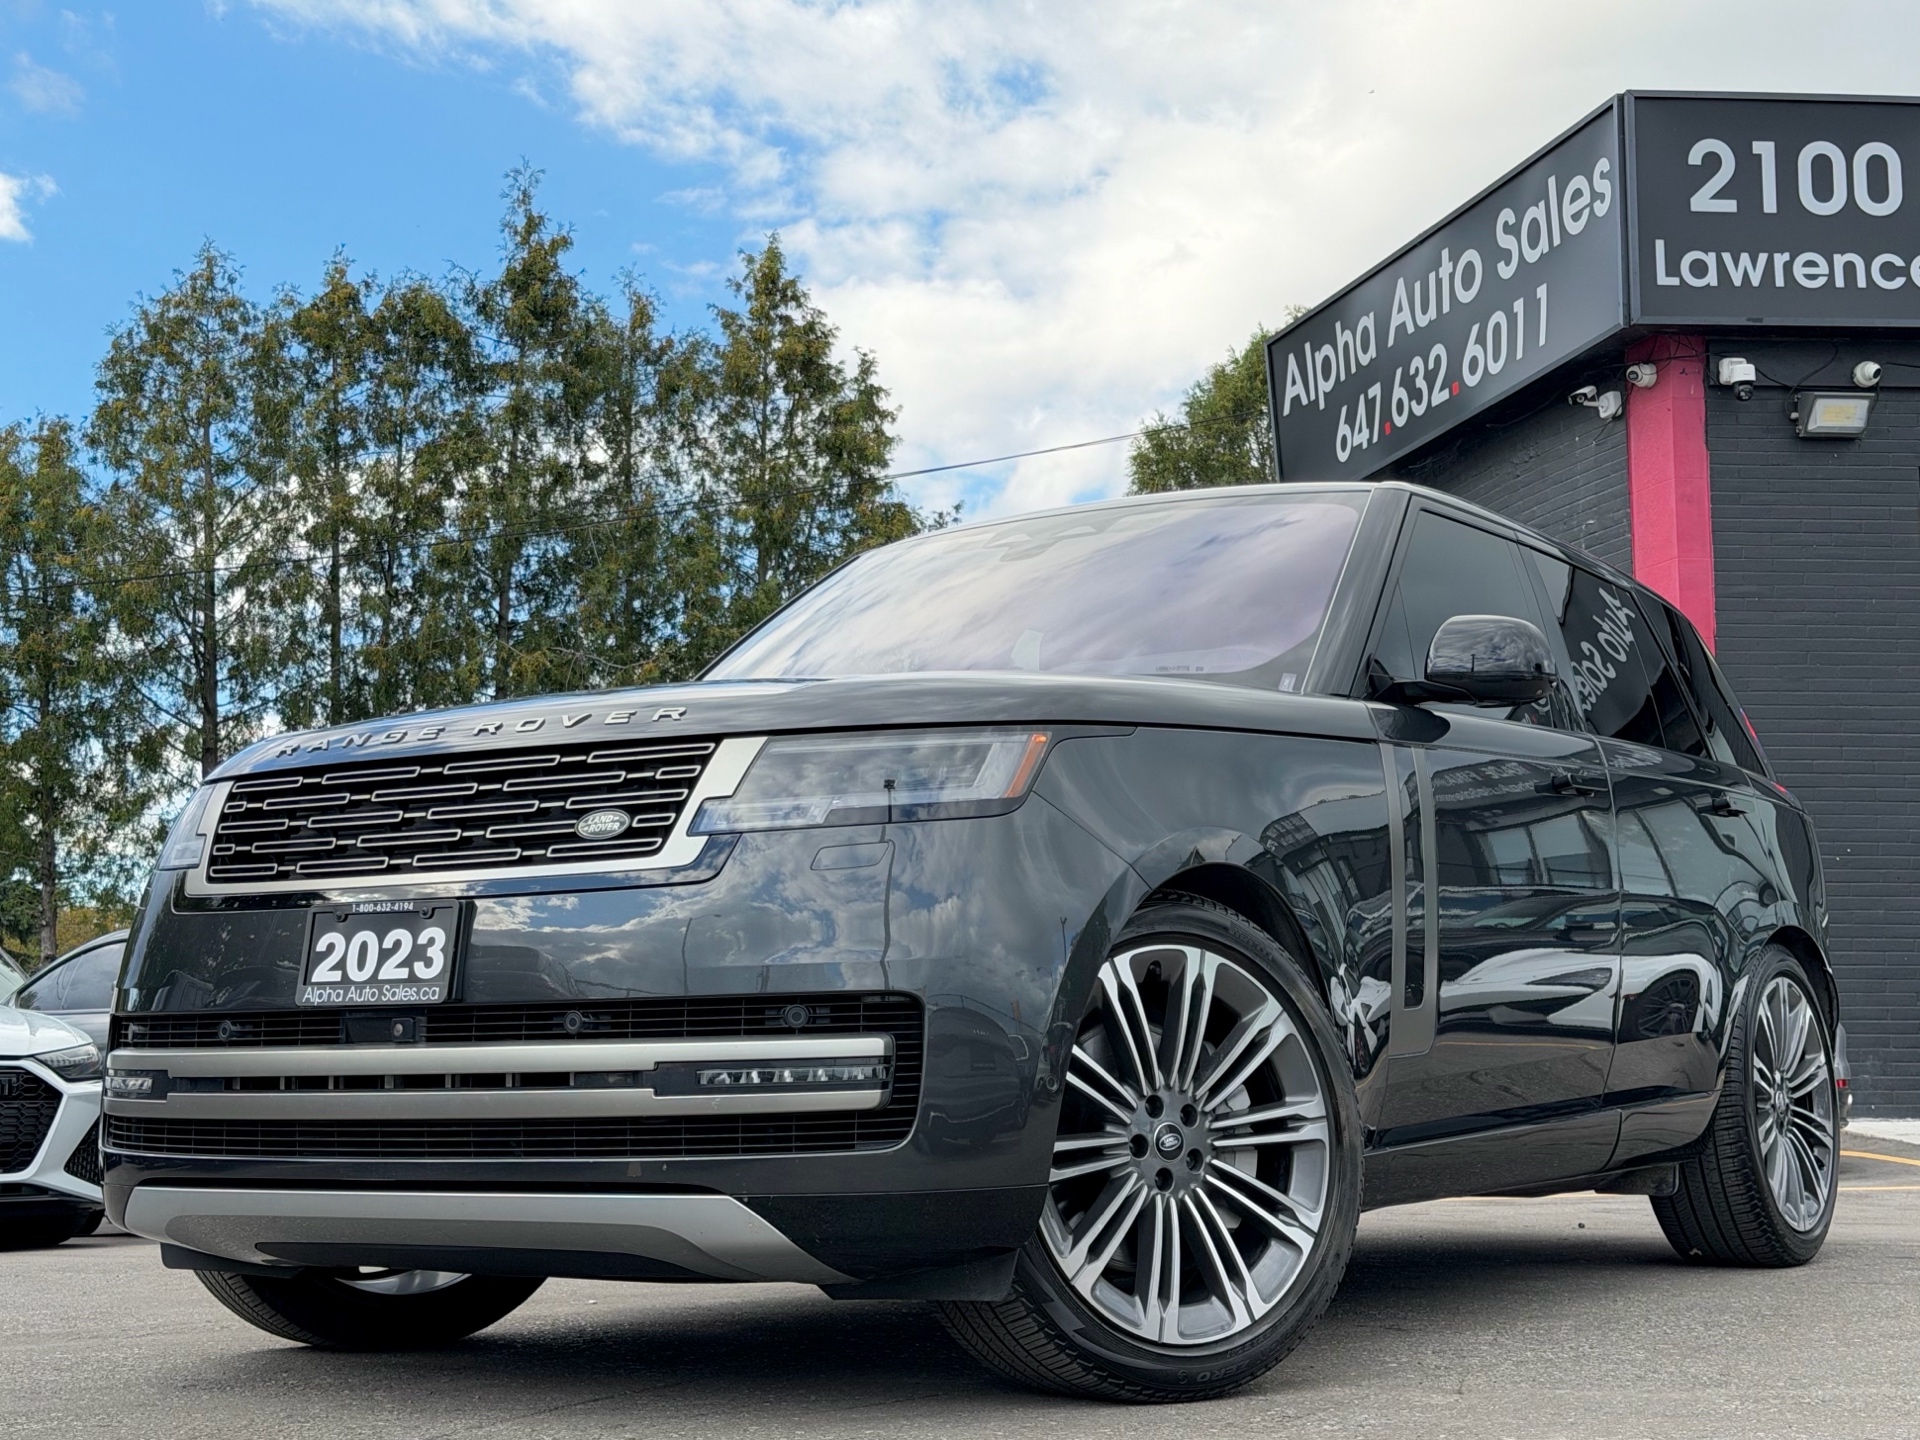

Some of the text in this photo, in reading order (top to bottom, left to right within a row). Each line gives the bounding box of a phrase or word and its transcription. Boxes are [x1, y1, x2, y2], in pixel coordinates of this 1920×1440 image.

[1687, 138, 1903, 217] 2100
[1282, 156, 1613, 418] Alpha Auto Sales
[1655, 238, 1920, 290] Lawrenc
[1335, 282, 1549, 464] 647.632.6011
[275, 706, 688, 759] RANGE ROVER
[587, 815, 614, 825] LAND
[587, 821, 621, 833] ROVER
[351, 901, 415, 913] 1-800-632-4194
[310, 926, 447, 983] 2023
[302, 984, 441, 1006] Alpha Auto Sales.ca
